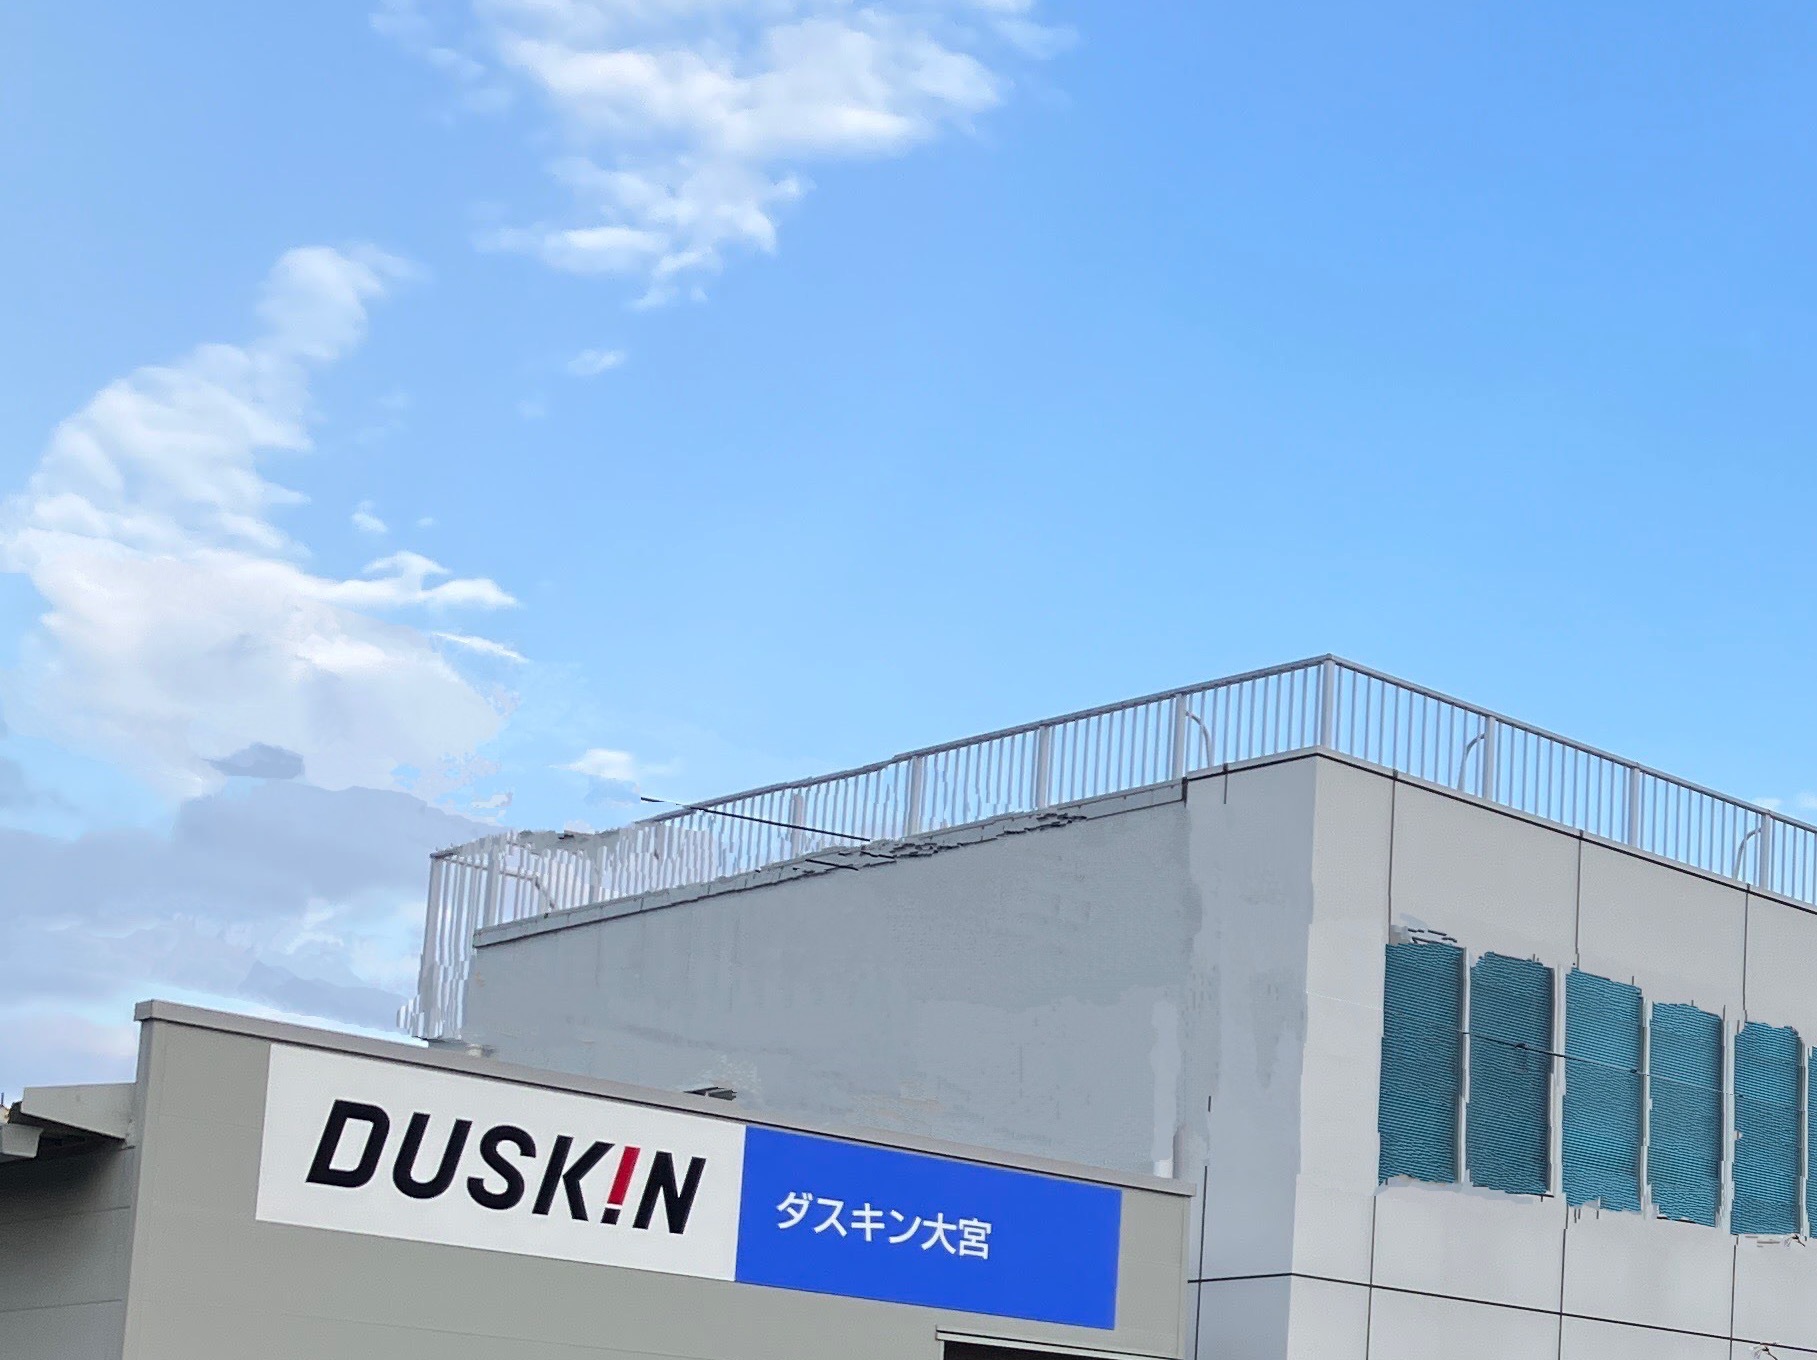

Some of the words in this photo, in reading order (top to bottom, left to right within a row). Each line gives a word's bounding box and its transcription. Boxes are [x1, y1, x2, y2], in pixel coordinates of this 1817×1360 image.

[776, 1191, 993, 1260] ダスキン大宮
